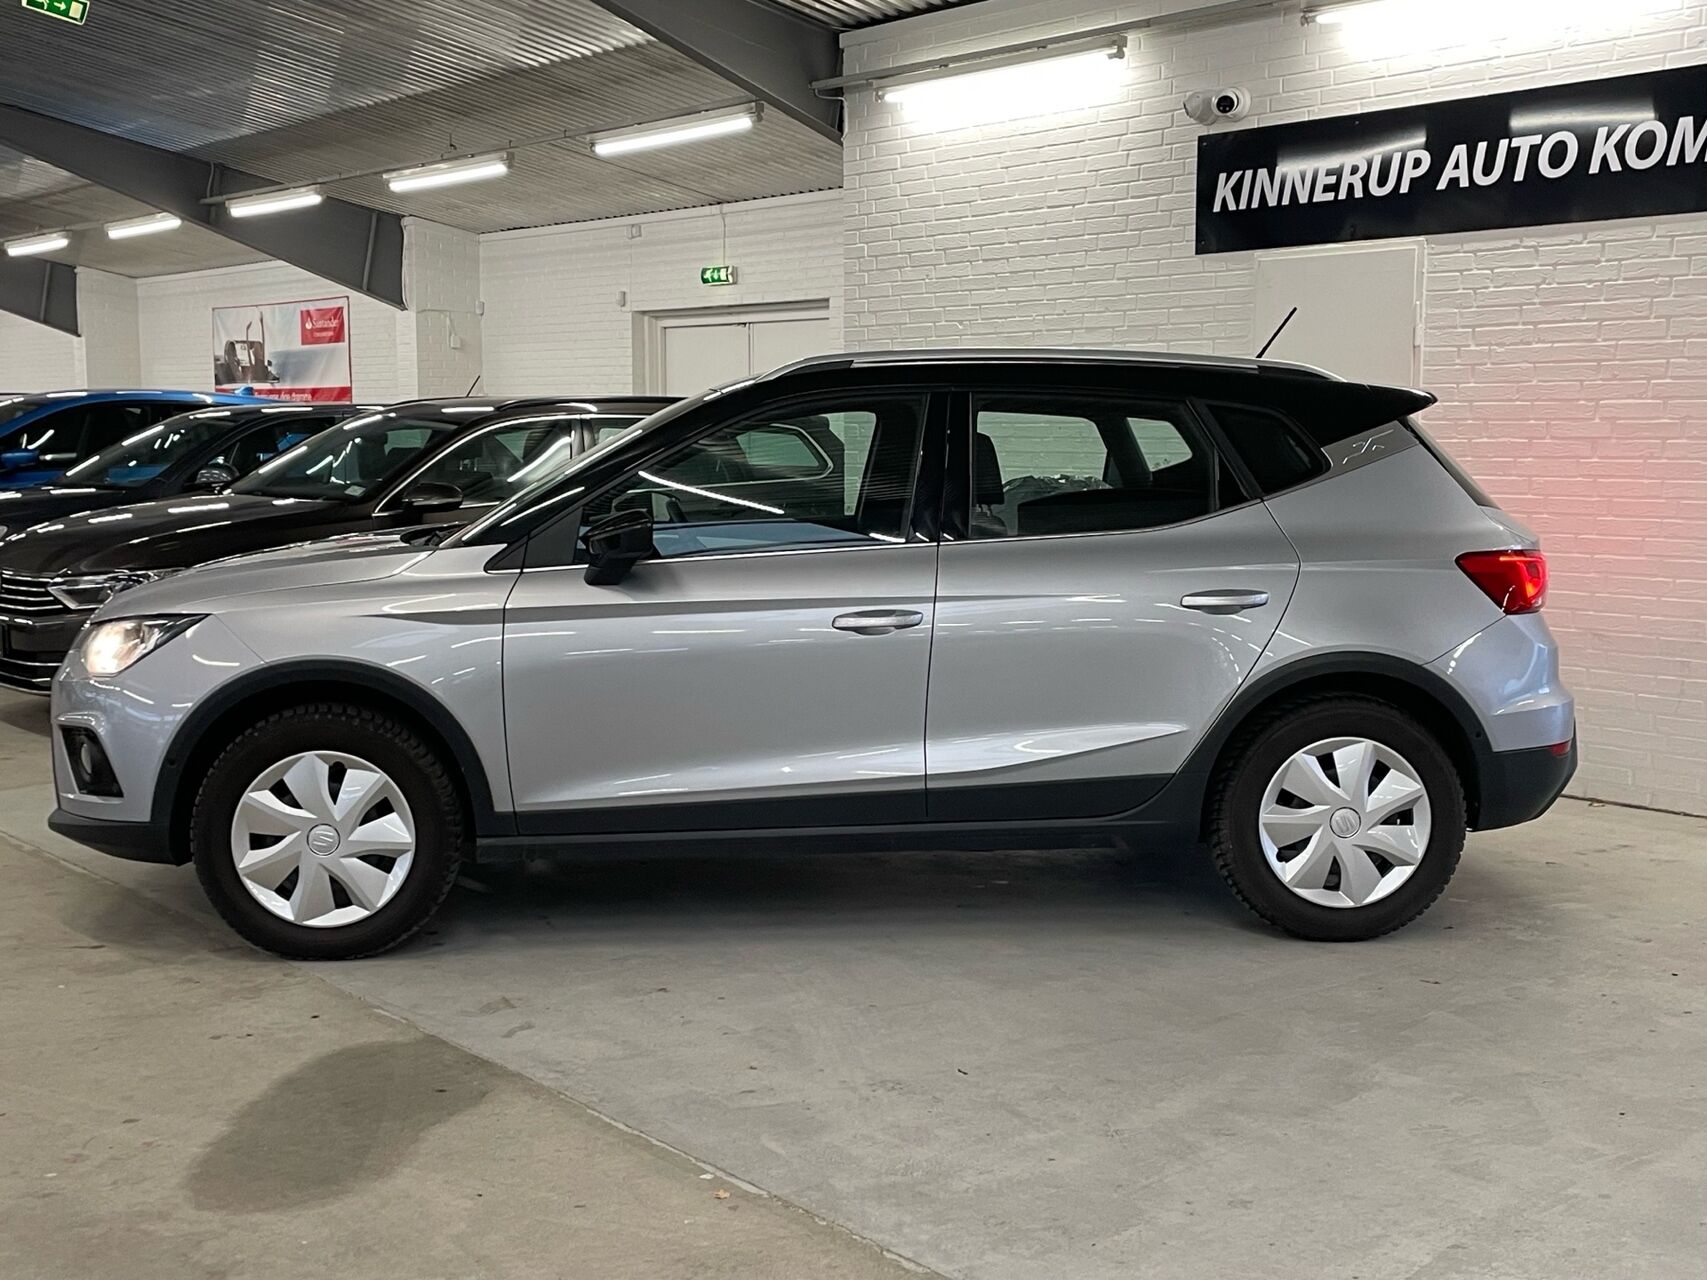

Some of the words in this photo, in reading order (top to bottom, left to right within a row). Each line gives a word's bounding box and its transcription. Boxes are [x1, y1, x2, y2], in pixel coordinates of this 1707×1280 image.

[1213, 149, 1431, 212] KINNERUP
[1436, 131, 1578, 191] AUTO
[1588, 115, 1707, 174] KOM
